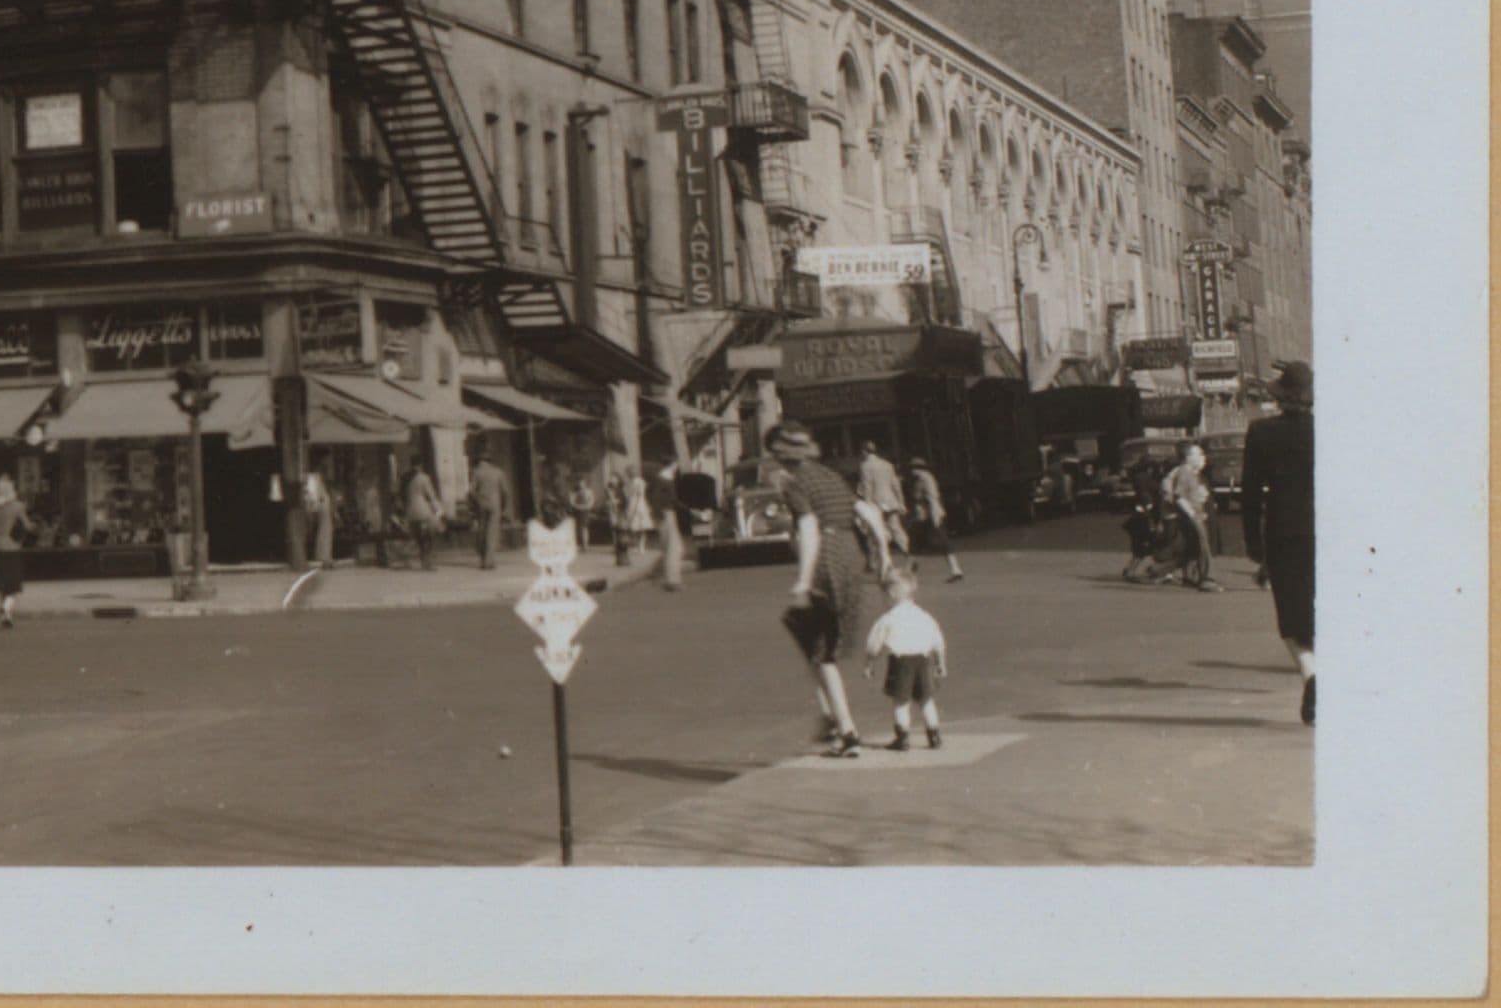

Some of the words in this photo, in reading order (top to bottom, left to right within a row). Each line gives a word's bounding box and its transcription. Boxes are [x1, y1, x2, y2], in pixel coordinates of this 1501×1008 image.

[185, 197, 265, 218] FLORIST
[682, 108, 714, 304] BILLIARDS
[1203, 266, 1216, 337] GARAGE
[807, 335, 896, 355] ROYAL
